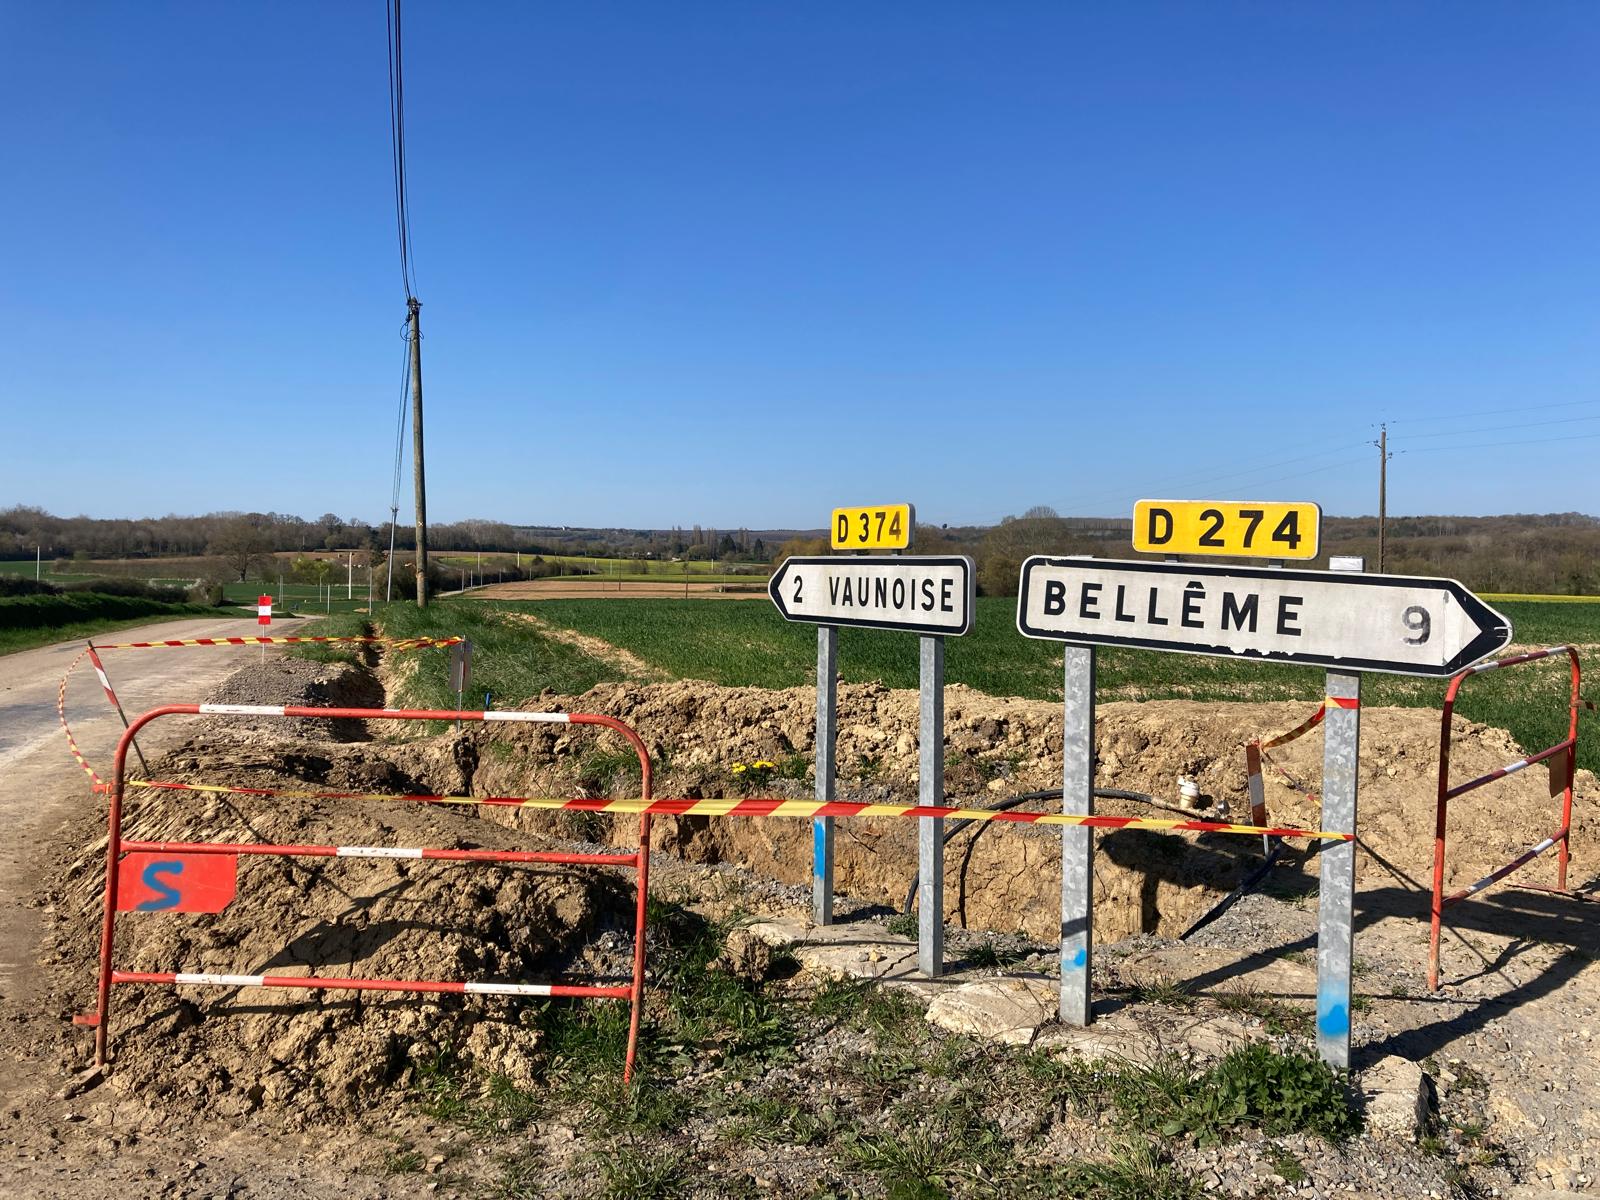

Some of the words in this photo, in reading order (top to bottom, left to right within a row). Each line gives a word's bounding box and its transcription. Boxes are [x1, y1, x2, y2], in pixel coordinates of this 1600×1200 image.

[837, 513, 849, 543] D
[858, 510, 902, 543] 374
[1148, 508, 1174, 545] D
[1199, 508, 1302, 550] 274
[793, 575, 803, 604] 2
[828, 576, 954, 613] VAUNOISE
[1043, 579, 1304, 637] BELLÊME
[1401, 604, 1432, 646] 9
